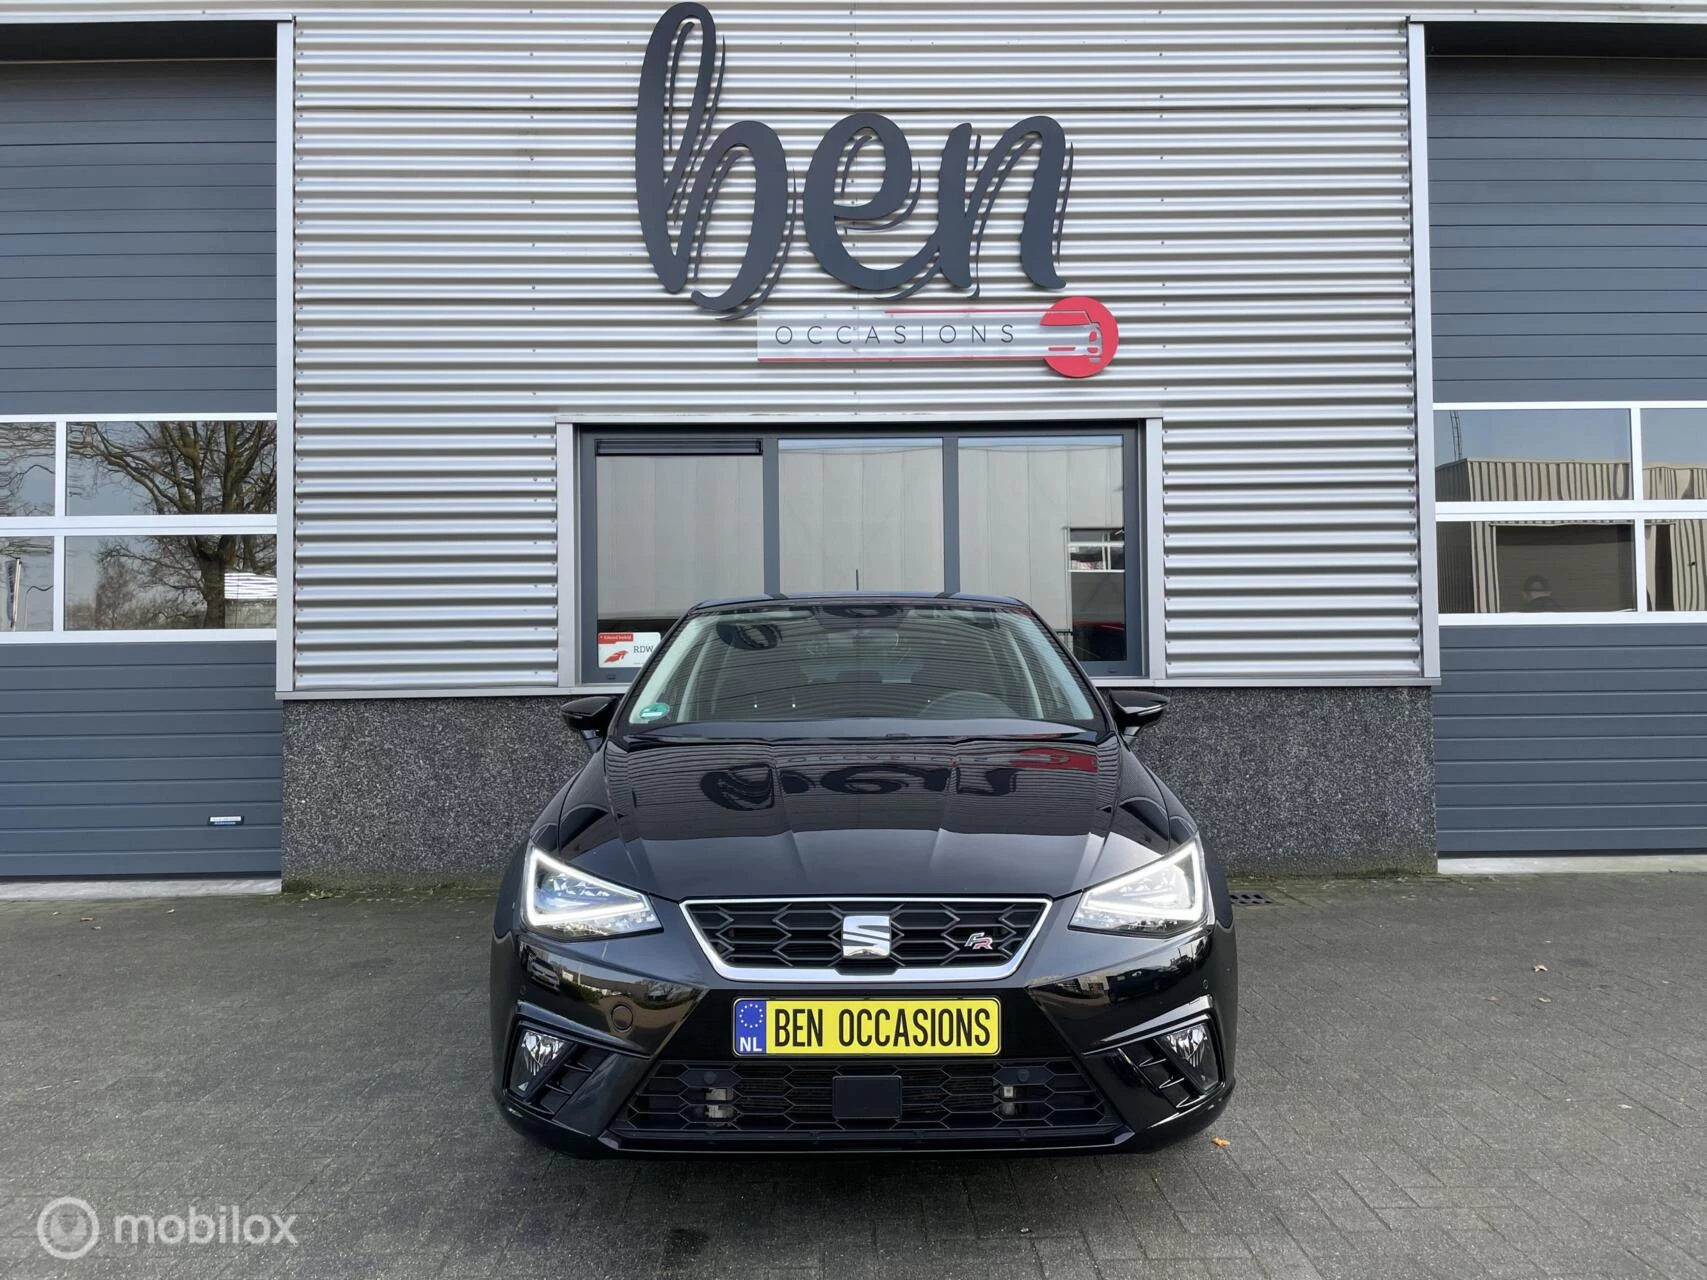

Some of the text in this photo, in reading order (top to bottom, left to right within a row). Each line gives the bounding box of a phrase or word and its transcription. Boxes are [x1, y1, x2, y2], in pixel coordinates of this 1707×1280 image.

[636, 2, 1073, 319] ben
[774, 325, 1016, 345] OCCASIONS
[633, 645, 654, 653] RDW
[964, 932, 993, 950] FR
[774, 1008, 990, 1047] BEN OCCASIONS
[739, 1037, 763, 1052] NL
